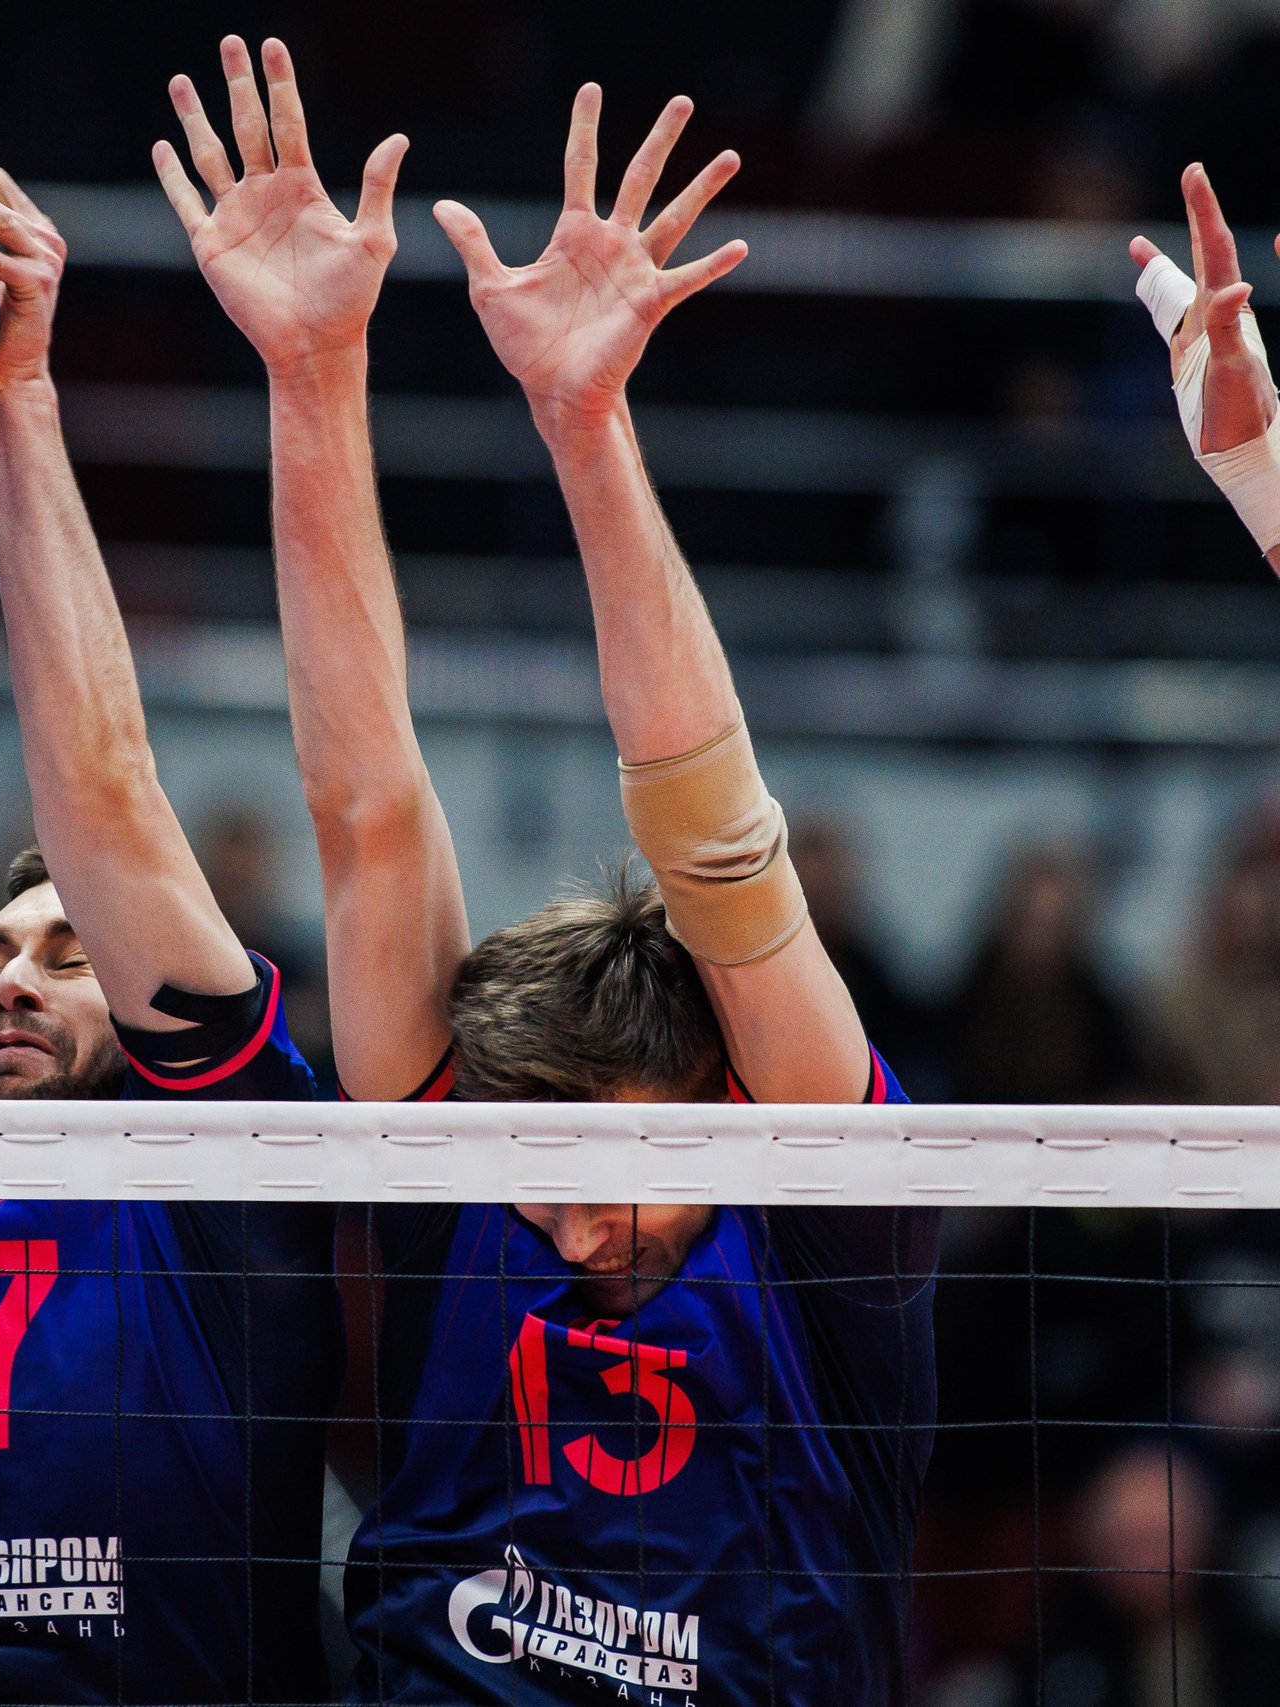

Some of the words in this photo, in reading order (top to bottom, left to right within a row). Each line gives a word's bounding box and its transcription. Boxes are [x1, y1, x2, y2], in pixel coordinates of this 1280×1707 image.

[509, 1312, 697, 1497] 13
[535, 1633, 693, 1685] ТРАНСГАЗ
[536, 1580, 700, 1660] ГАЗПРОМ
